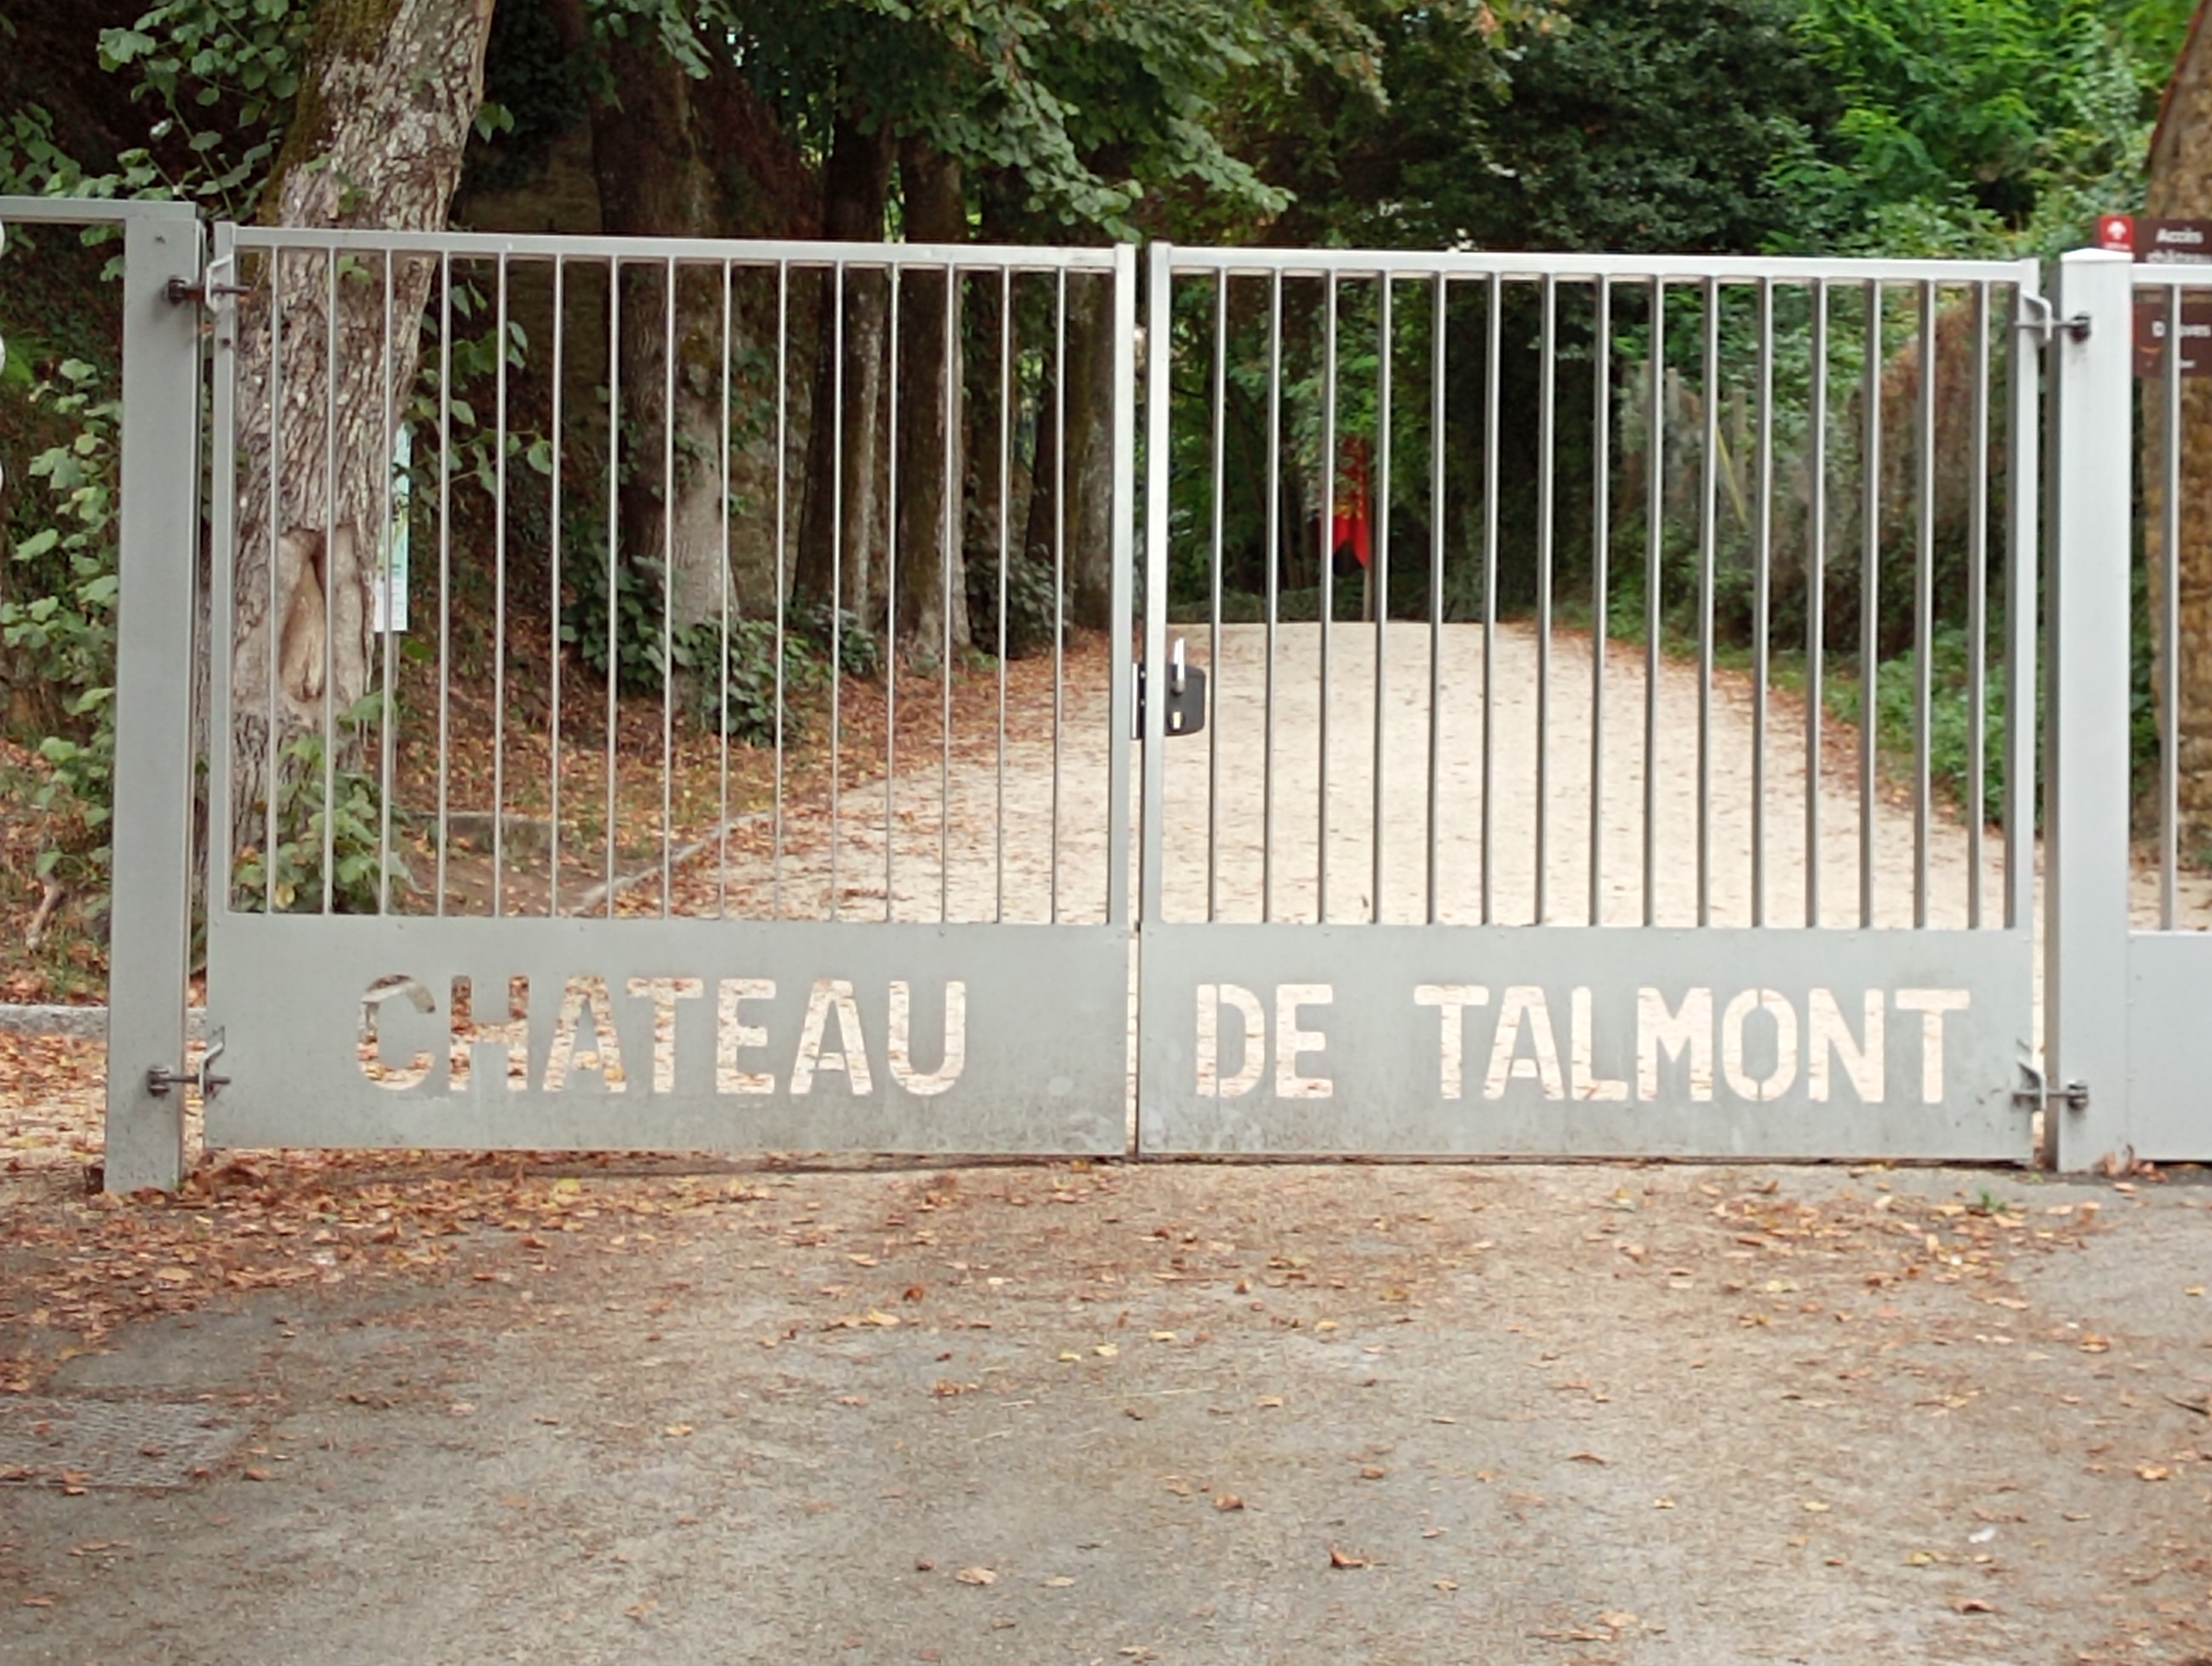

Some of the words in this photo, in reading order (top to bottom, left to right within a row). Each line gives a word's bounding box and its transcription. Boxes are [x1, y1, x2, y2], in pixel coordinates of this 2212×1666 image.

[357, 975, 966, 1095] CHATEAU
[1195, 983, 1334, 1099] DE
[1413, 985, 1971, 1104] TALMONT
